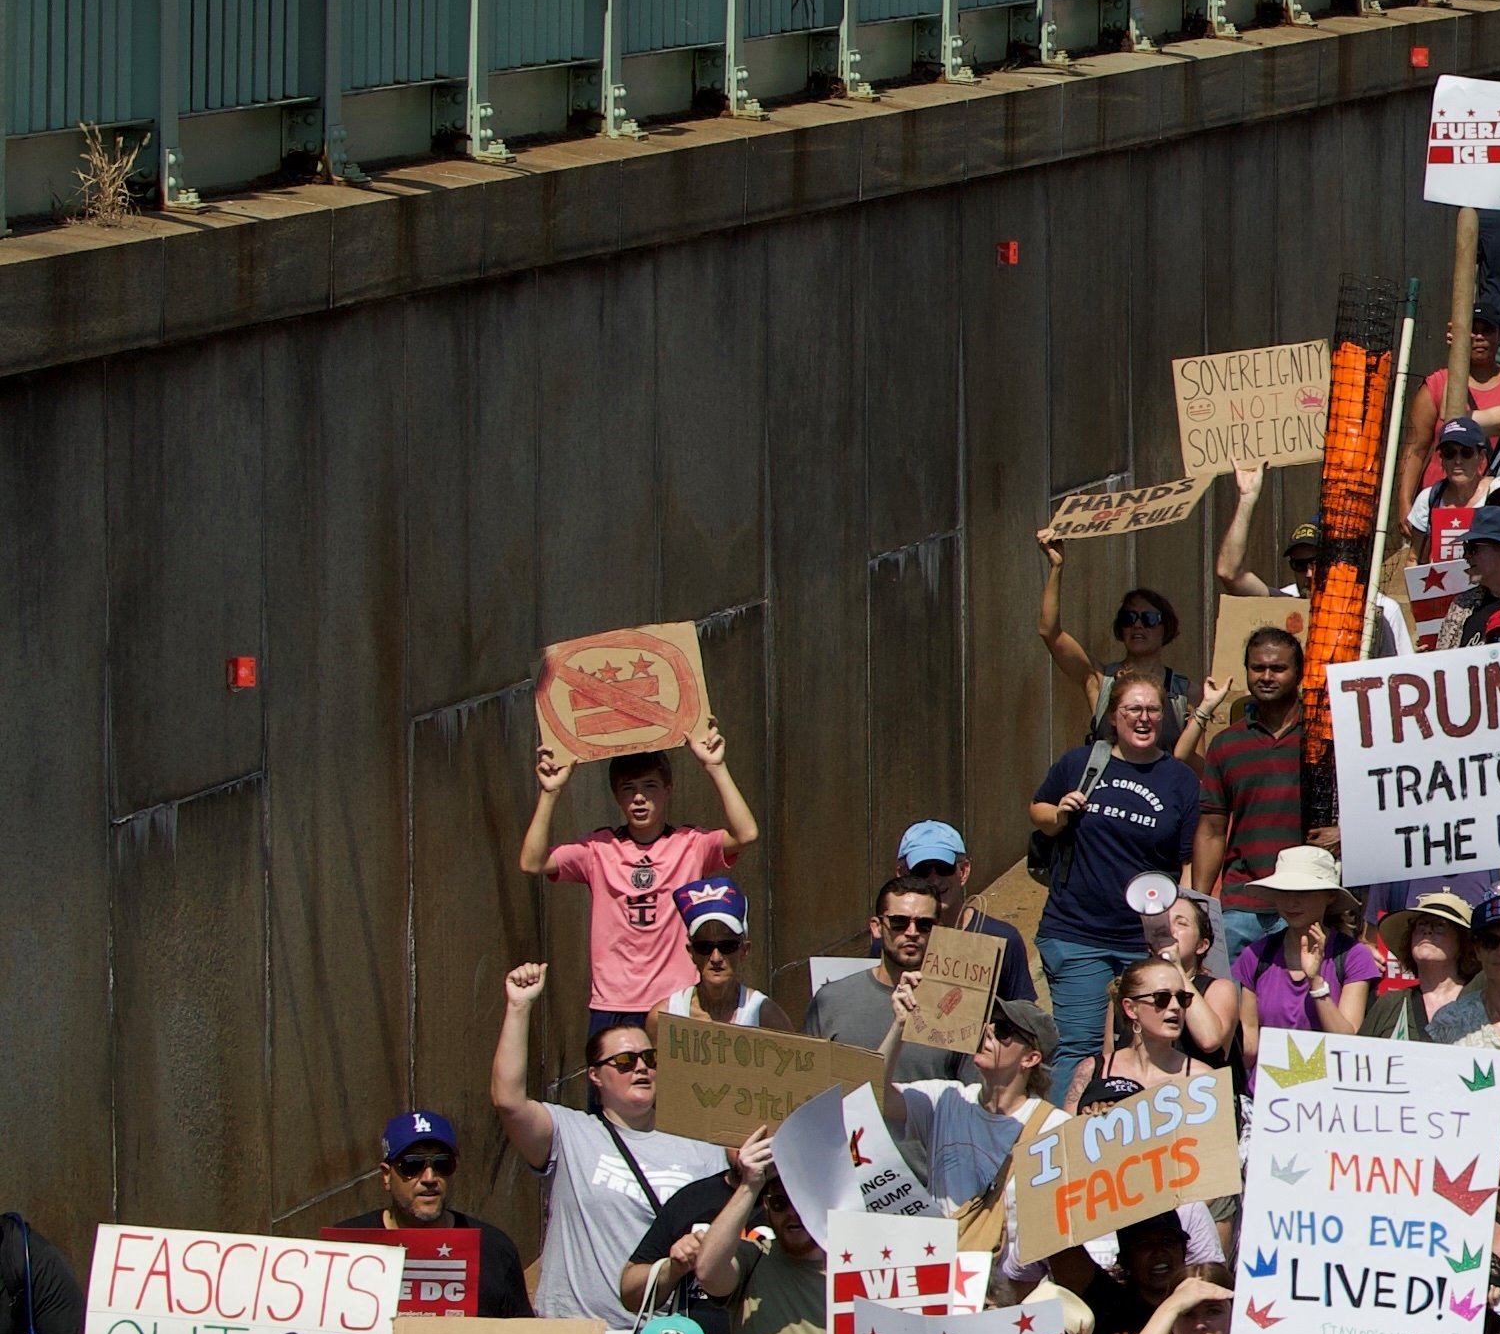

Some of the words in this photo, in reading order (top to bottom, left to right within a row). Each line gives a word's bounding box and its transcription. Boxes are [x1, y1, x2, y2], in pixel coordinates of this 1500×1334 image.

[1181, 344, 1324, 399] SOVEREIGNTY
[1230, 392, 1282, 418] NOT
[1189, 411, 1327, 466] SOVEREIGNS
[1395, 817, 1478, 868] THE
[1331, 1051, 1406, 1085] THE
[1030, 1136, 1062, 1185] I
[1083, 1077, 1218, 1162] MISS
[1264, 1098, 1469, 1139] SMALLEST
[1053, 1139, 1201, 1236] FACTS
[1329, 1151, 1422, 1196] MAN
[1270, 1211, 1343, 1243] WHO
[1370, 1218, 1448, 1257] EVER
[105, 1232, 388, 1331] FASCISTS
[1290, 1257, 1445, 1319] LIVED!
